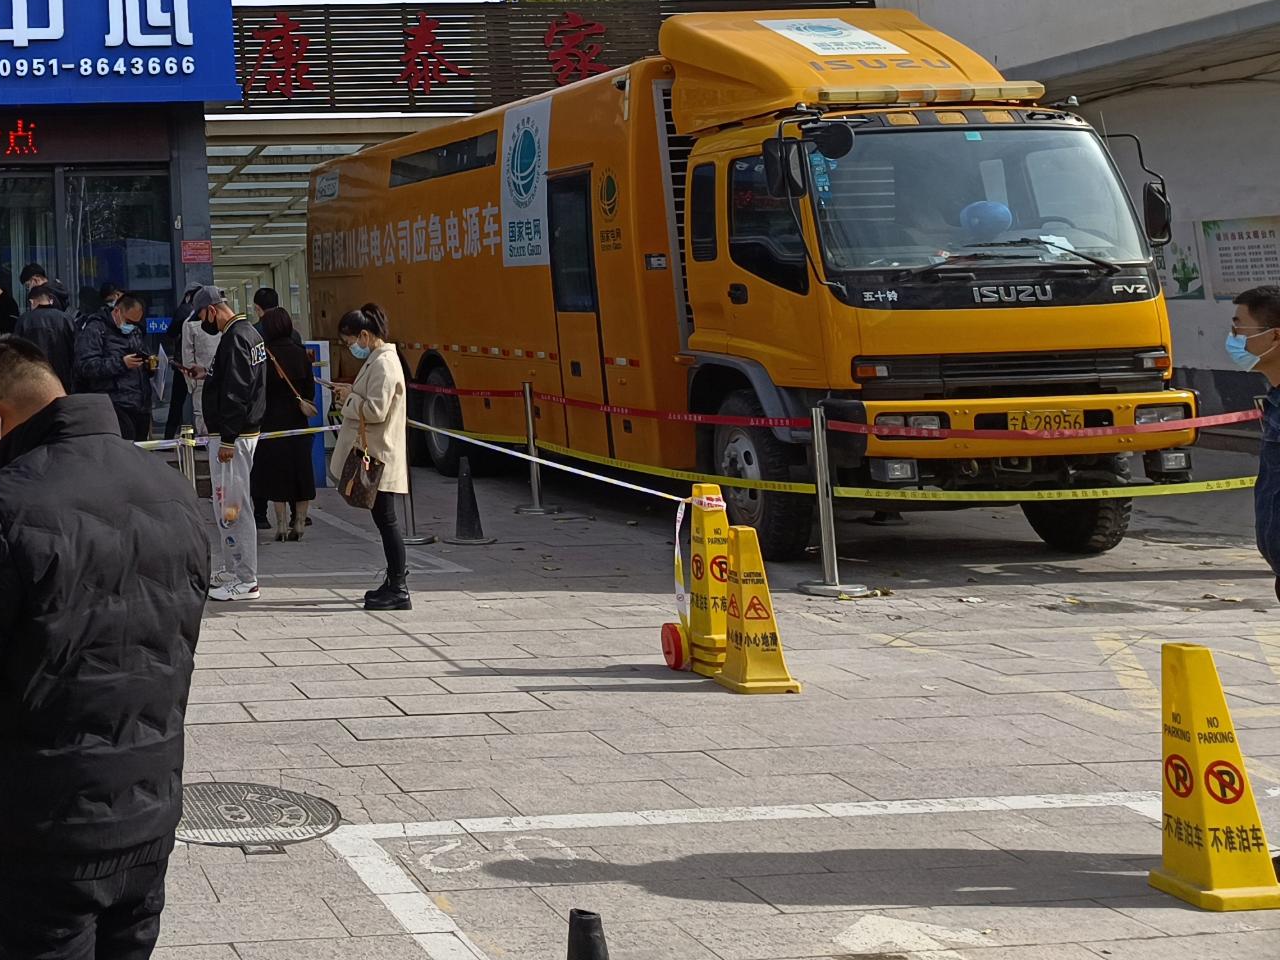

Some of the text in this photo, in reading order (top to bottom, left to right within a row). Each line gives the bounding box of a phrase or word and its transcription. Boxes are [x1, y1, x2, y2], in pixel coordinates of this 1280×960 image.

[808, 58, 952, 72] ISUZU
[508, 218, 542, 243] 国家电网
[863, 290, 898, 302] 五十铃
[972, 285, 1053, 303] ISUZU
[1112, 284, 1148, 295] FVZ
[744, 631, 778, 648] 小心地滑
[1172, 711, 1182, 725] NO
[1206, 716, 1219, 729] NO
[1164, 724, 1192, 743] PARKING
[1197, 731, 1235, 744] PARKING
[1164, 813, 1205, 851] 不准泊车
[1208, 824, 1265, 853] 不准泊车
